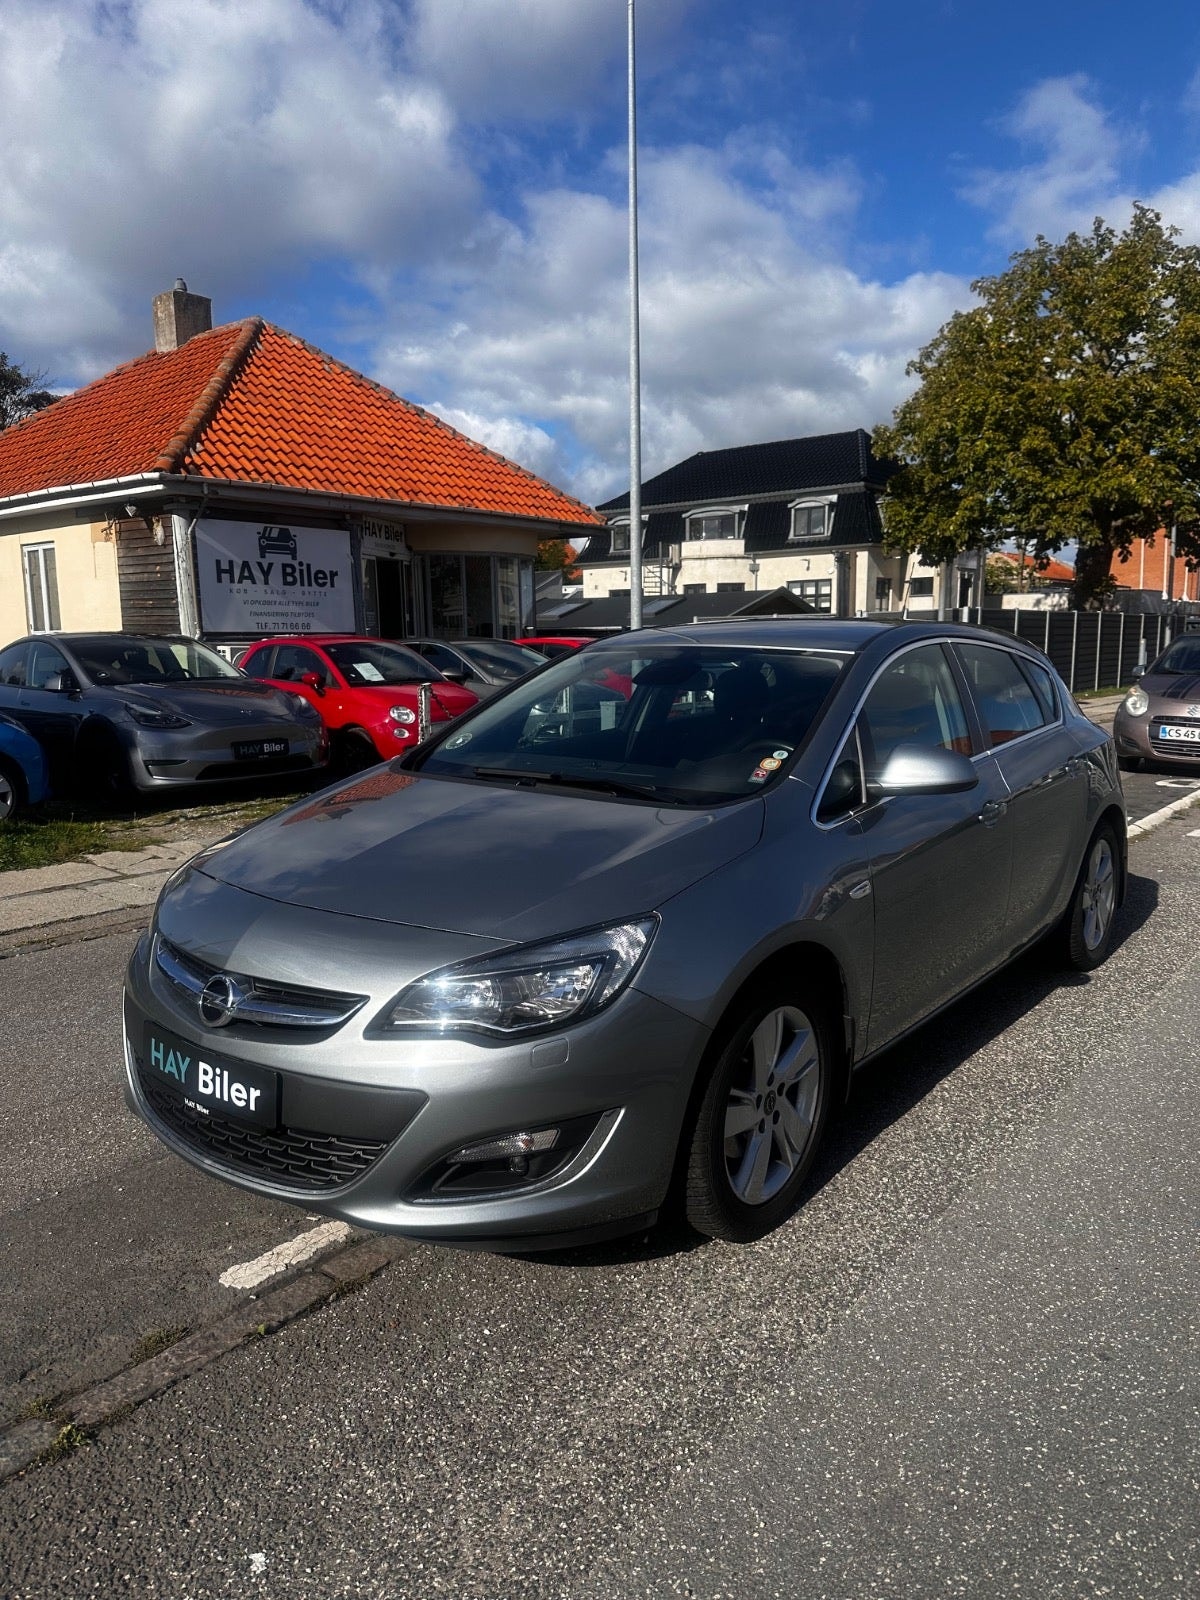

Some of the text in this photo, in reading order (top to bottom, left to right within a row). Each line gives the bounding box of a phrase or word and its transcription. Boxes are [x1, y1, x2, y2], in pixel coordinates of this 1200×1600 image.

[364, 520, 404, 542] HAY Biler
[215, 559, 339, 588] HAY Biler
[1168, 728, 1182, 738] CS
[1183, 729, 1196, 739] 45
[240, 743, 285, 754] HAY Biler
[151, 1038, 261, 1112] HAY Biler
